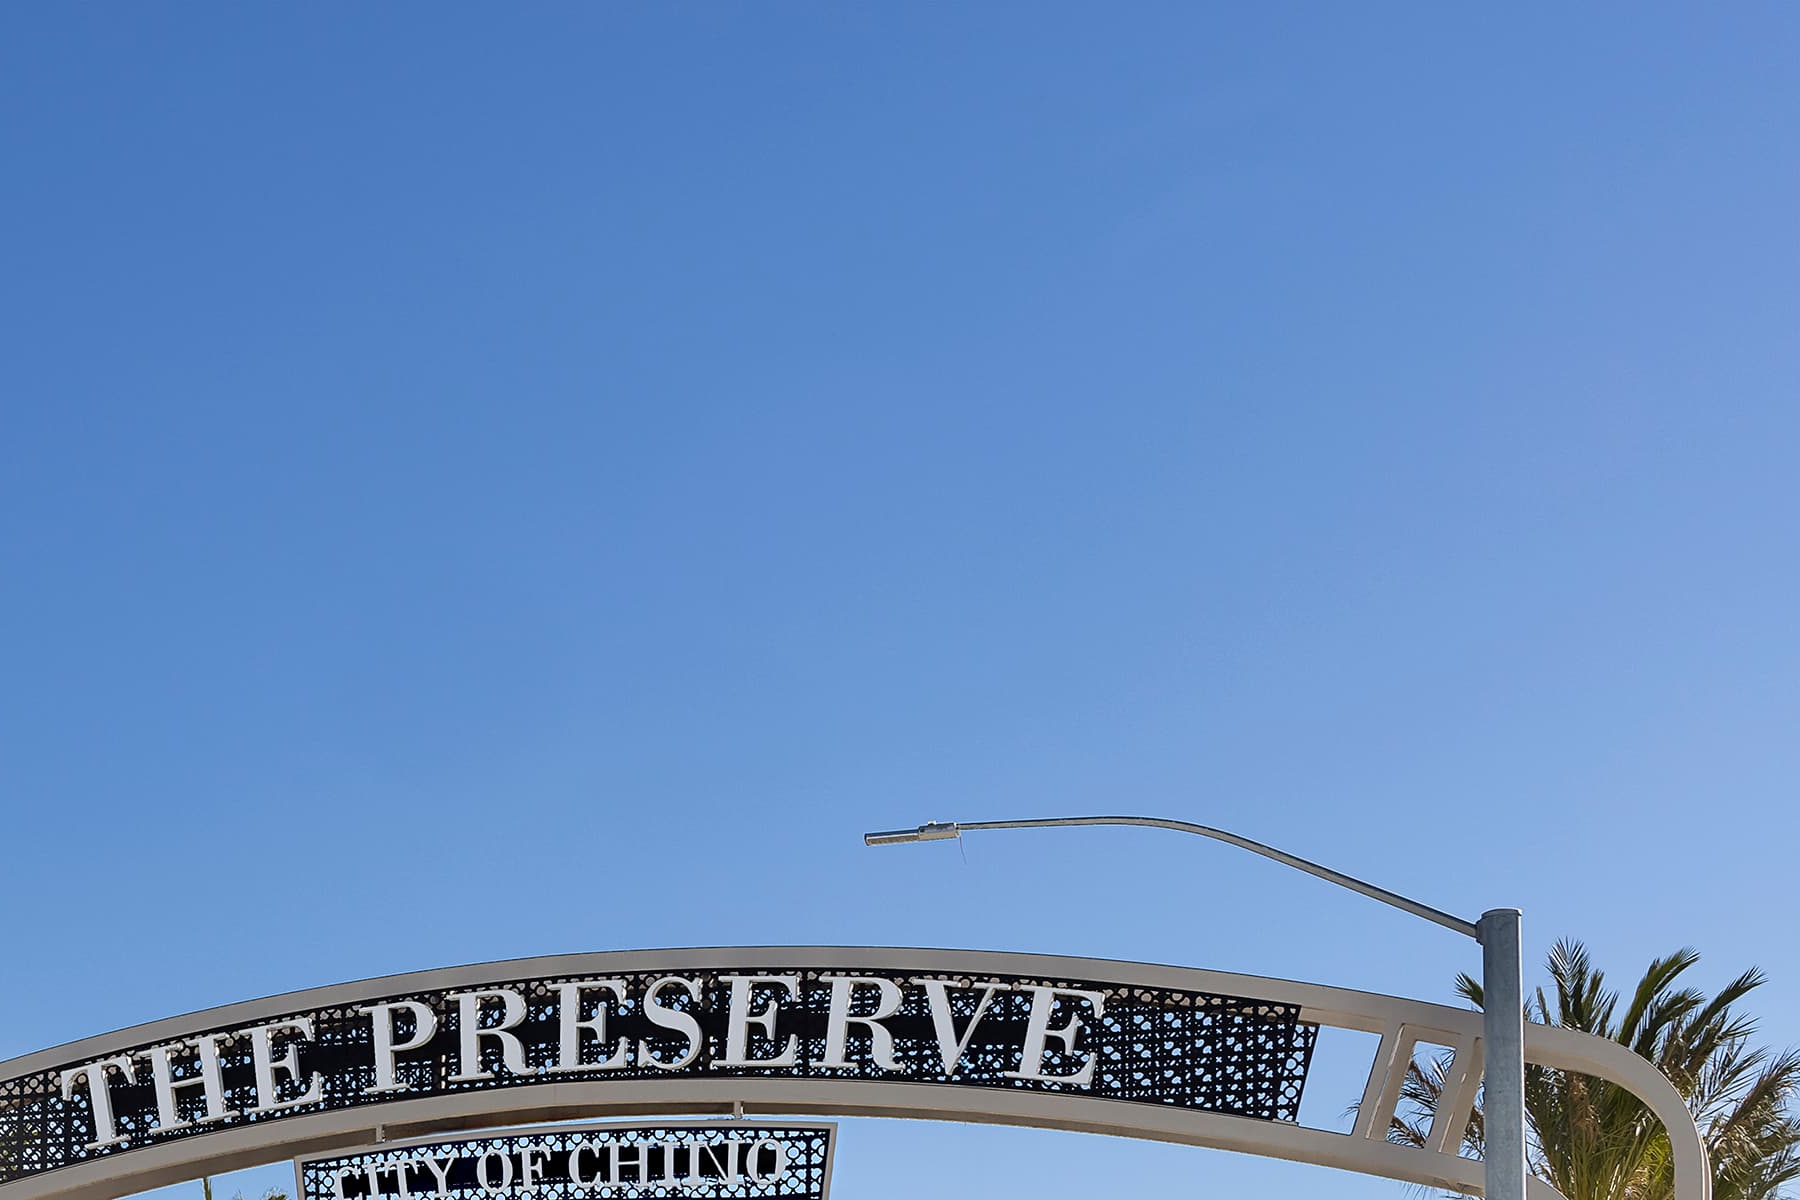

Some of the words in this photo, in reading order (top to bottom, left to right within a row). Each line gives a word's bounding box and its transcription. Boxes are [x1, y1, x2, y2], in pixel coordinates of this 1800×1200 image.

[60, 1018, 322, 1149] THE
[358, 975, 1105, 1093] PRESERVE
[476, 1144, 552, 1194] OF
[568, 1138, 787, 1188] CHINO
